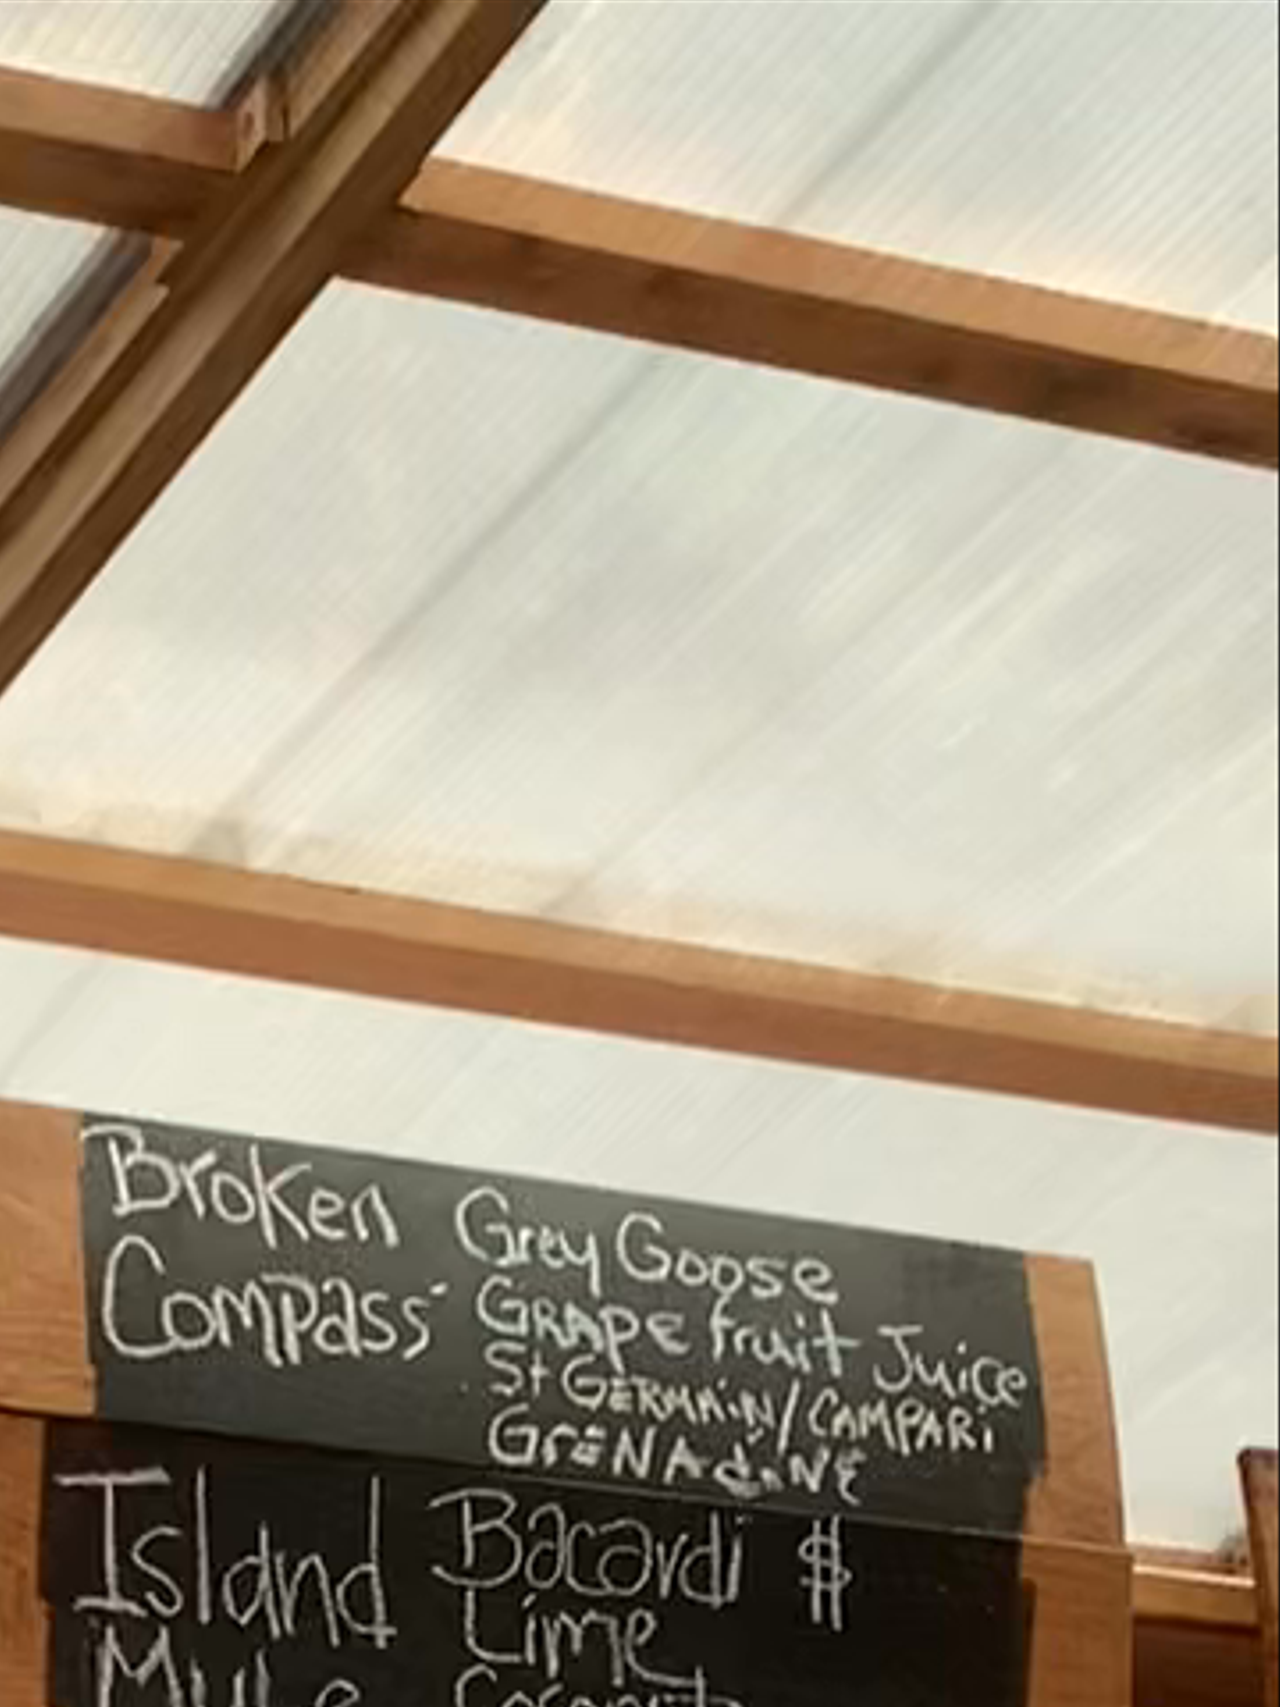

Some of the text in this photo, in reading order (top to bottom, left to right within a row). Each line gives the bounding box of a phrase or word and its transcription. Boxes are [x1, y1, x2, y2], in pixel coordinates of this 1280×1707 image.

[454, 1187, 839, 1305] Grey Goose
[872, 1325, 1028, 1407] Juice
[53, 1464, 398, 1650] Island
[428, 1487, 751, 1610] Bacardi
[464, 1588, 703, 1688] Lime
